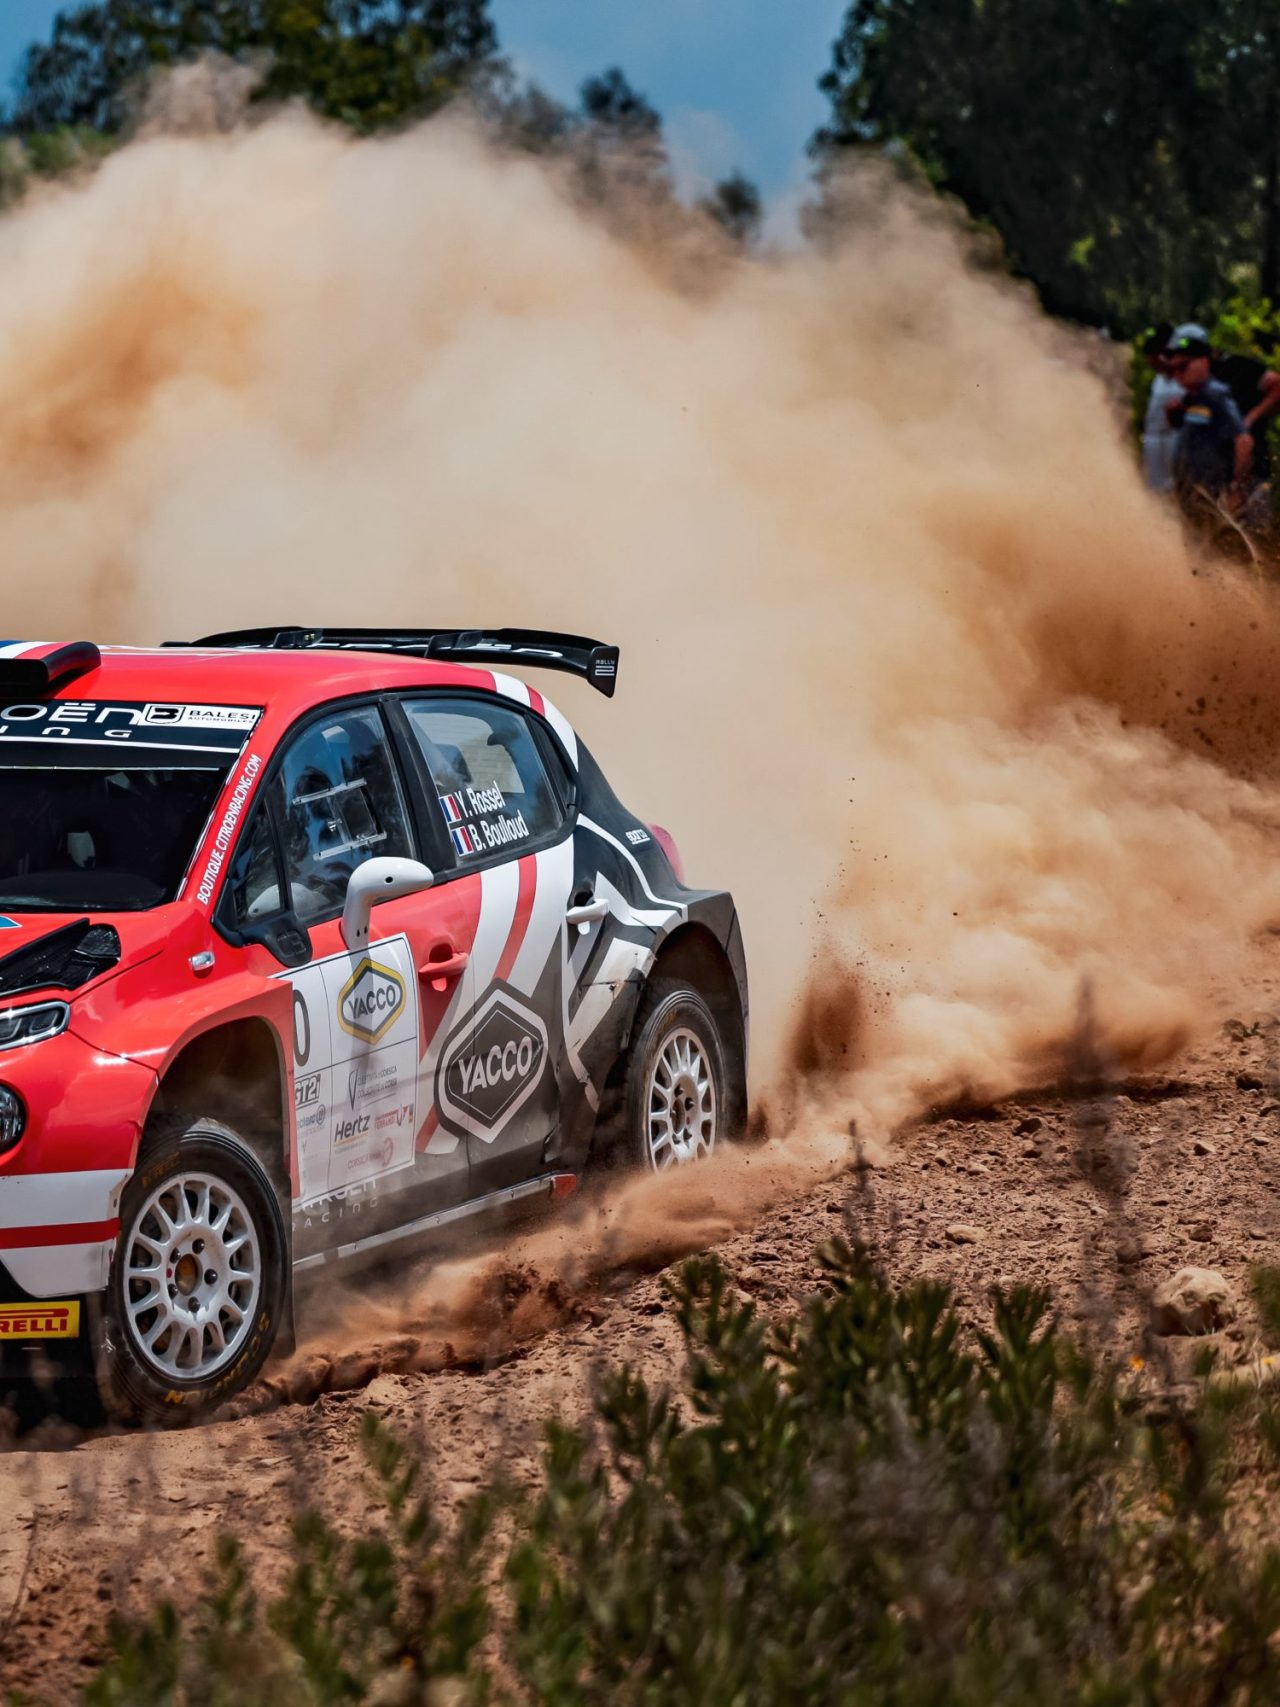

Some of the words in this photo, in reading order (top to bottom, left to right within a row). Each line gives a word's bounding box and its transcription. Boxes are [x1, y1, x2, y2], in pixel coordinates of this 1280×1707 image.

[189, 710, 256, 720] BALESI
[454, 790, 473, 818] Y.
[466, 780, 506, 815] Rossel
[196, 753, 262, 905] BOUTIQUE.CITROENRACING.COM
[468, 824, 487, 851] B.
[480, 809, 530, 847] Boulloud
[348, 987, 396, 1019] YACCO
[458, 1035, 533, 1095] YACCO
[335, 1115, 370, 1142] Hertz
